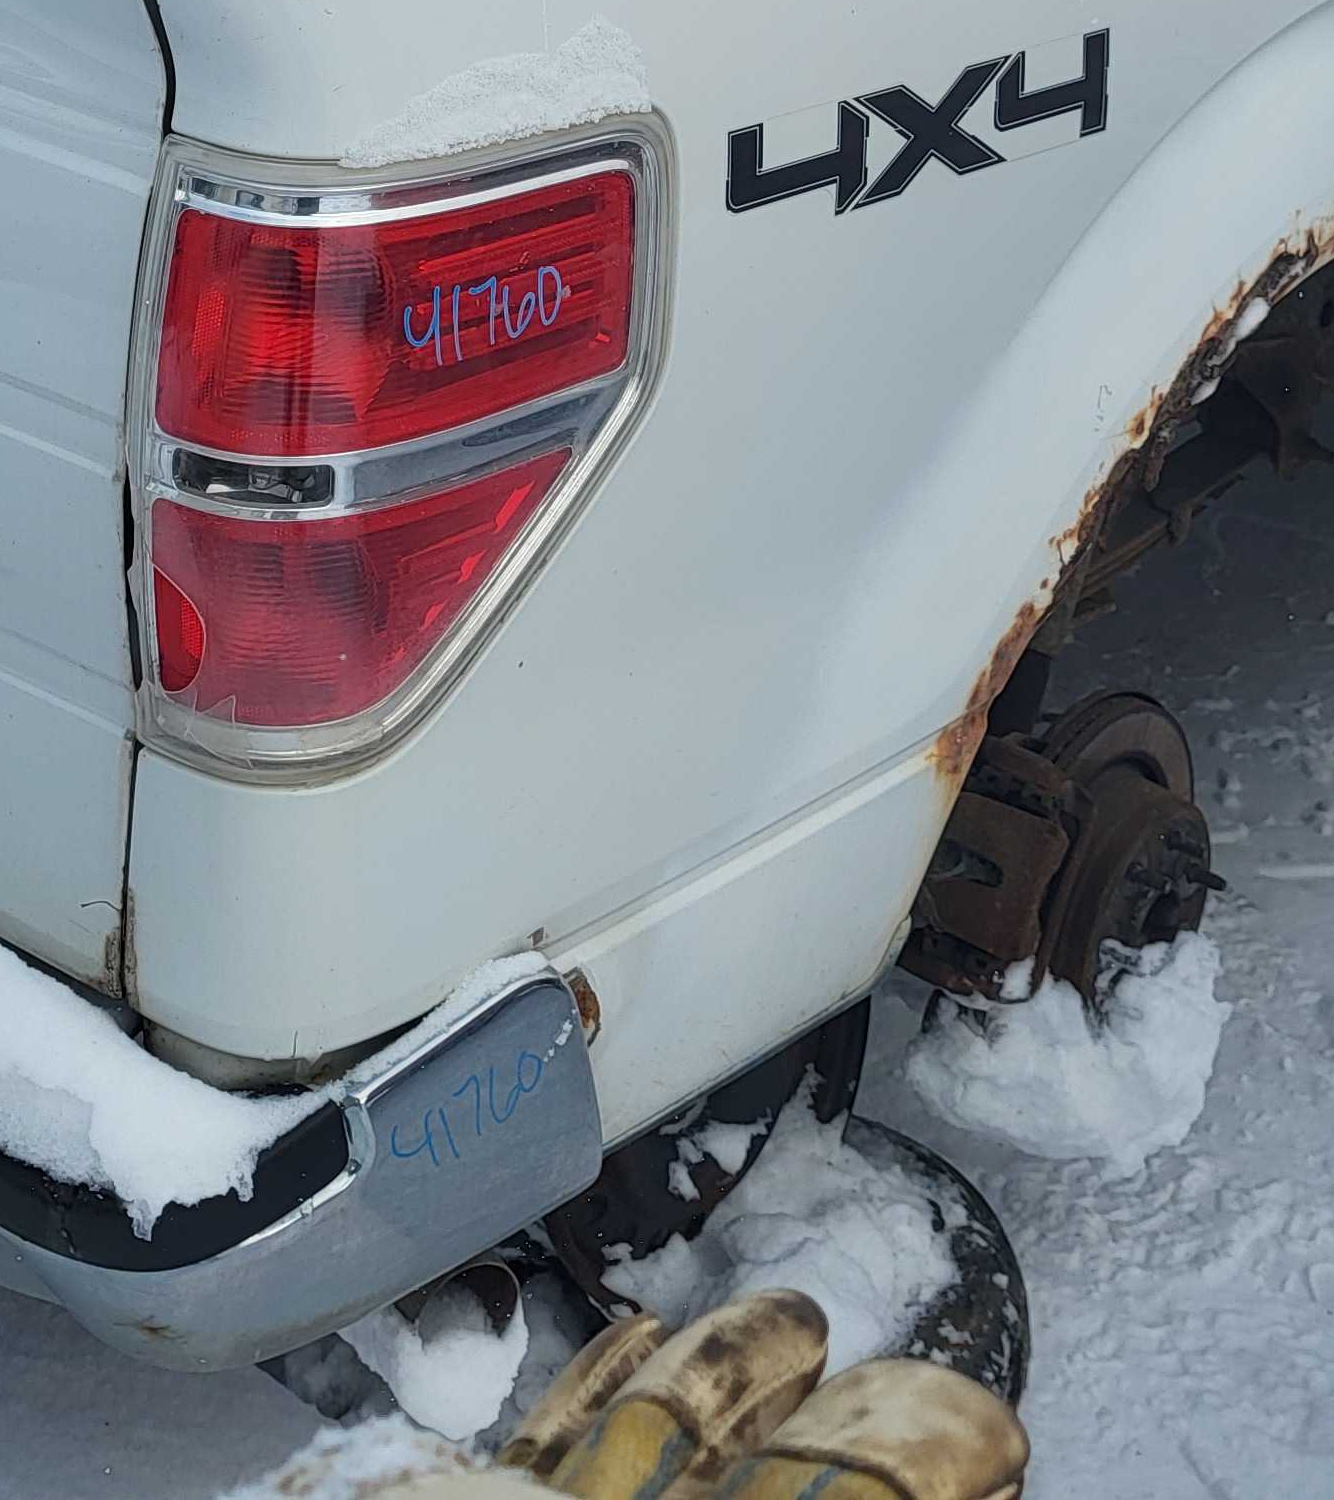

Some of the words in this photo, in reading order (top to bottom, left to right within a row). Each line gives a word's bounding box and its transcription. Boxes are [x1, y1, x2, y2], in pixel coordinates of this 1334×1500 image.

[726, 28, 1109, 216] 4X4
[403, 266, 562, 366] 41760
[391, 1052, 544, 1167] 41760
